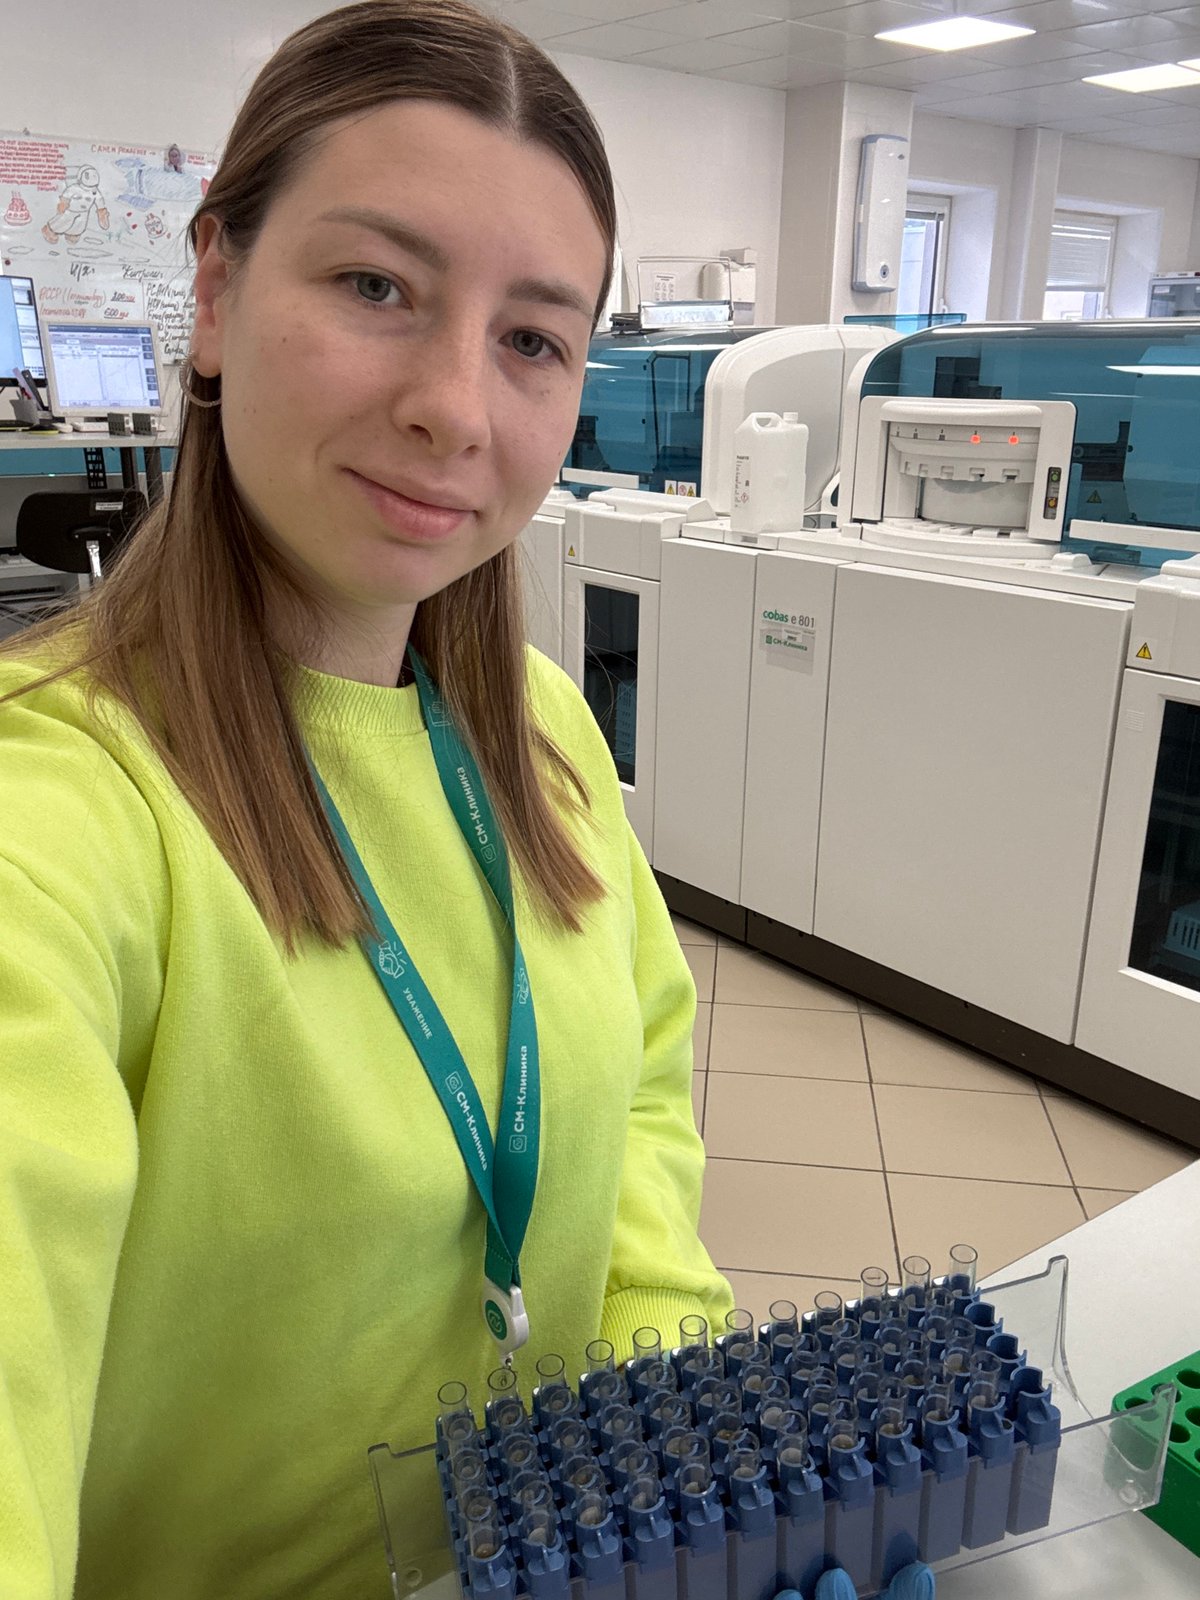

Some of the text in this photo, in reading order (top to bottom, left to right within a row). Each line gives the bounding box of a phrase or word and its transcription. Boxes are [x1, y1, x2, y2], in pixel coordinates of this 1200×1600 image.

[762, 609, 815, 628] cobas e 801
[457, 767, 488, 844] СМ-Клиника
[403, 987, 433, 1040] УВАЖЕНИЕ
[514, 1045, 527, 1133] СМ-Клиника
[456, 1091, 487, 1171] СМ-Клиника
